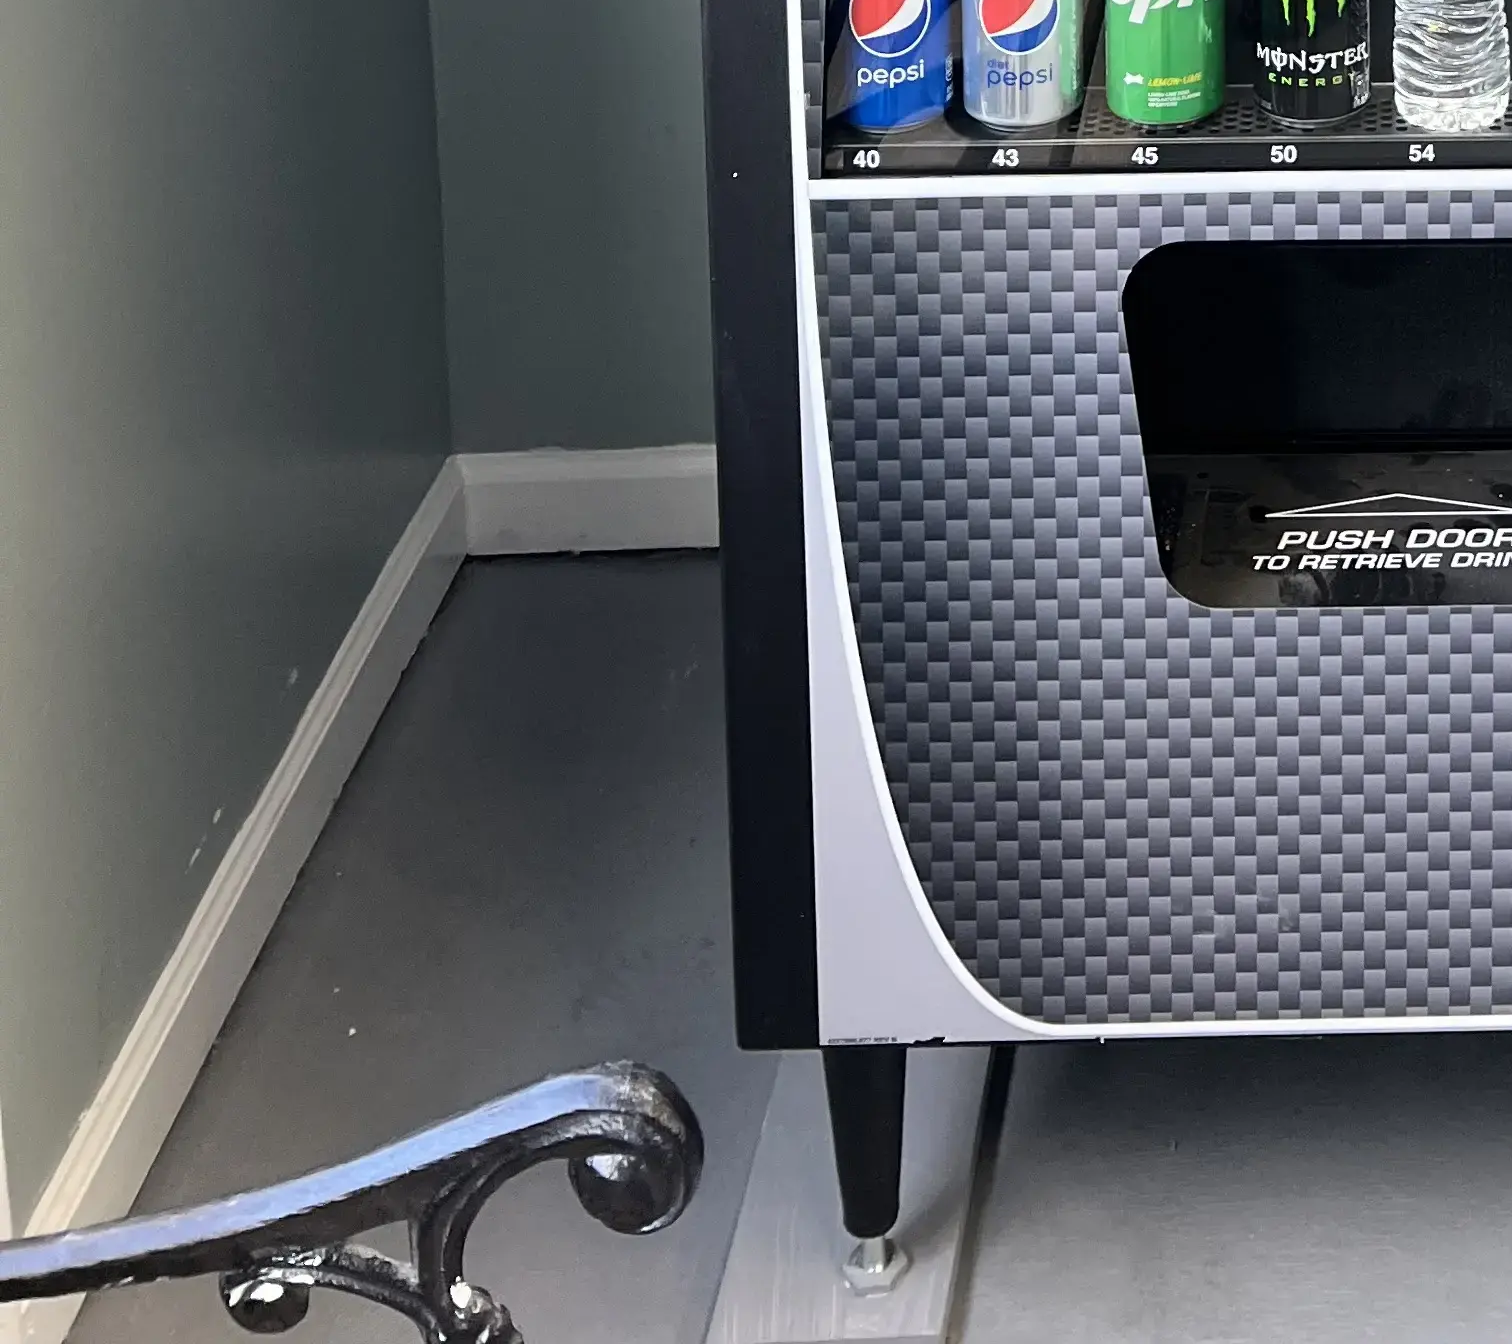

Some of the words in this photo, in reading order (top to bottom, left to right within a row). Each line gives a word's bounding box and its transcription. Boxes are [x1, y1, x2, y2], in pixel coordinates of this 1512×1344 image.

[1256, 41, 1369, 74] MONSTER
[857, 59, 925, 88] pepsi
[987, 62, 1053, 90] pepsi
[853, 149, 880, 168] 40
[991, 148, 1019, 167] 43
[1131, 146, 1159, 165] 45
[1270, 144, 1298, 163] 50
[1408, 143, 1435, 162] 54
[1276, 529, 1395, 550] PUSH
[1252, 554, 1293, 570] TO
[1297, 552, 1443, 570] RETRIEVE
